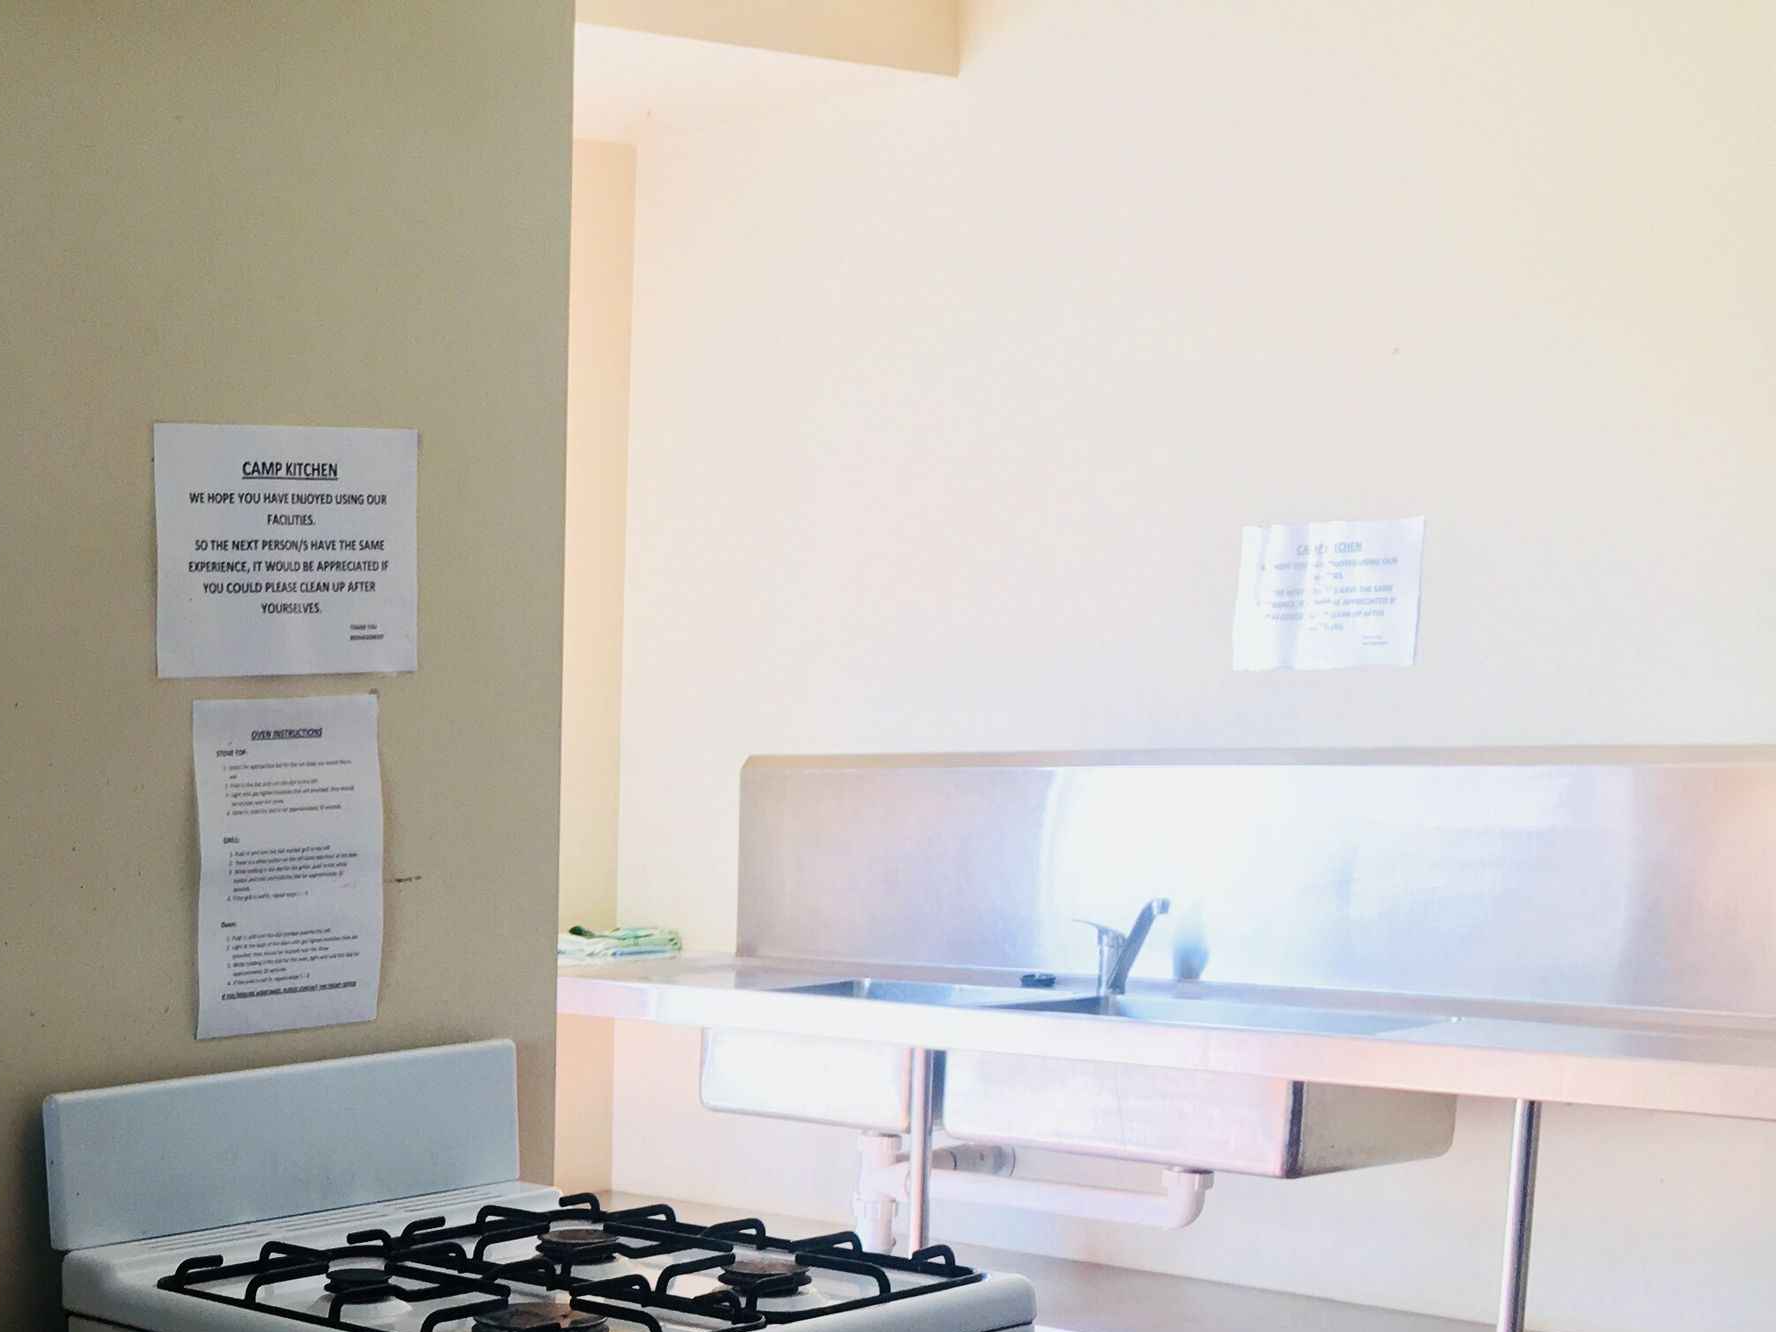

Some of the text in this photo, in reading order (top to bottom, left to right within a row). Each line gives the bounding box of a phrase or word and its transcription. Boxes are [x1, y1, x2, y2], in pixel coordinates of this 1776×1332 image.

[242, 461, 338, 477] CAMP KITCHEN
[189, 492, 387, 505] WE HOPE YOU HAVE ENJOYED USING OUR
[267, 514, 316, 526] FACILITIES.
[194, 539, 385, 553] SO THE NEXT PERSON/S HAVE THE SAME
[188, 560, 389, 574] EXPERIENCE, IT WOULD BE APPRECIATED IF
[203, 581, 376, 594] YOU COULD PLEASE CLEAN UP AFTER
[261, 603, 322, 615] YOURSELVES.
